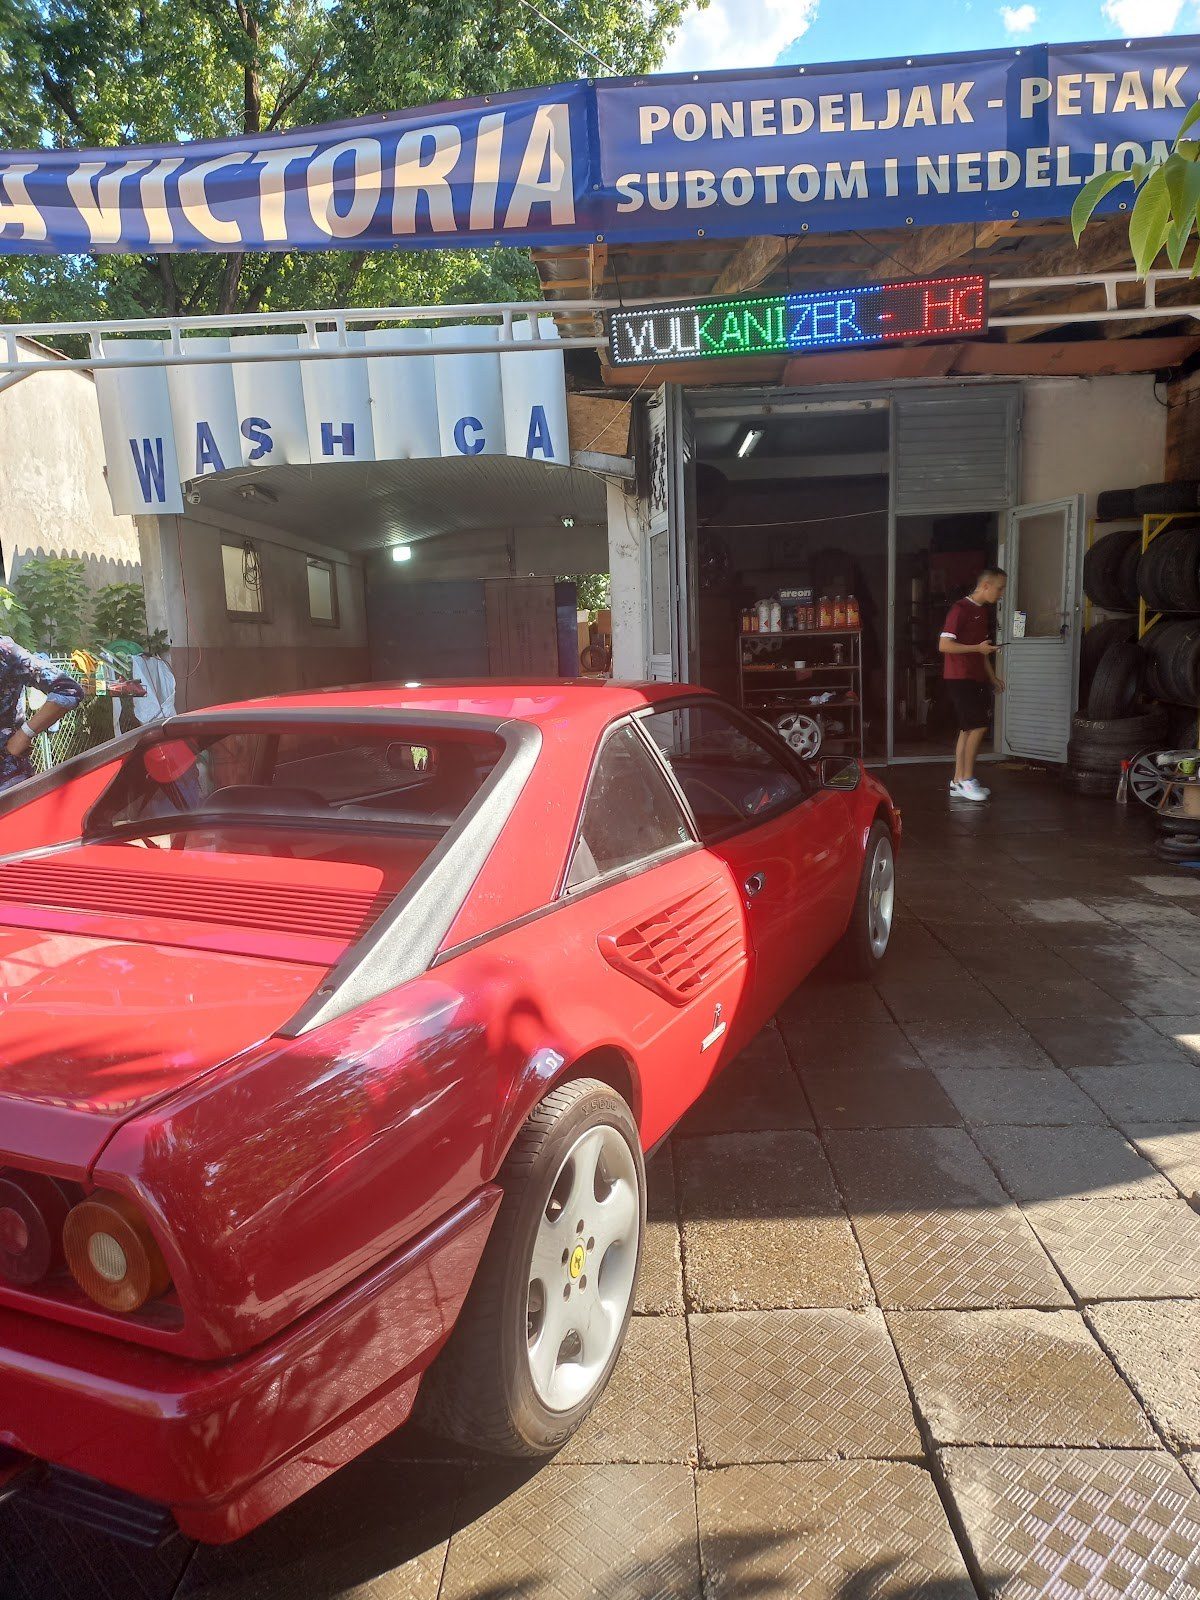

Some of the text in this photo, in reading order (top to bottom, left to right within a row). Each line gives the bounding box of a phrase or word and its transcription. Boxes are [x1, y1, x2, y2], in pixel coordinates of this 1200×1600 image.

[639, 81, 977, 145] PONEDELJAK
[1020, 65, 1190, 119] PETAK
[66, 103, 576, 243] VICTORIA
[616, 158, 869, 213] SUBOTOM
[885, 158, 899, 197] I
[625, 299, 862, 356] VULKANIZER
[780, 590, 811, 598] areon
